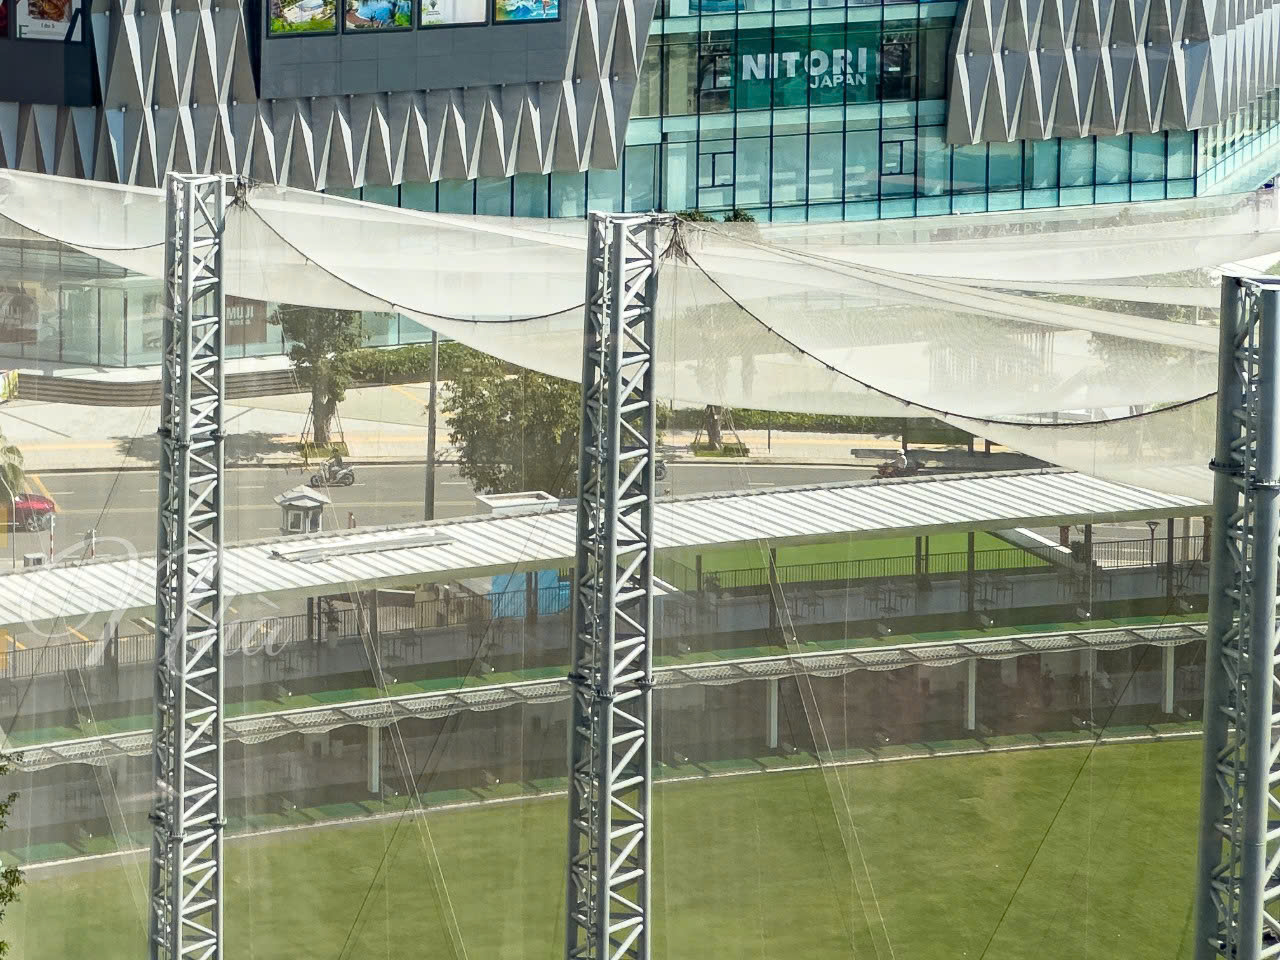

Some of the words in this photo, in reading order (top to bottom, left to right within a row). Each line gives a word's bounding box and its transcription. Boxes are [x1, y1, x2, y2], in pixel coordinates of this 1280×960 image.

[742, 48, 867, 80] NITORI
[810, 73, 867, 89] JAPAN
[226, 306, 254, 320] MUJI
